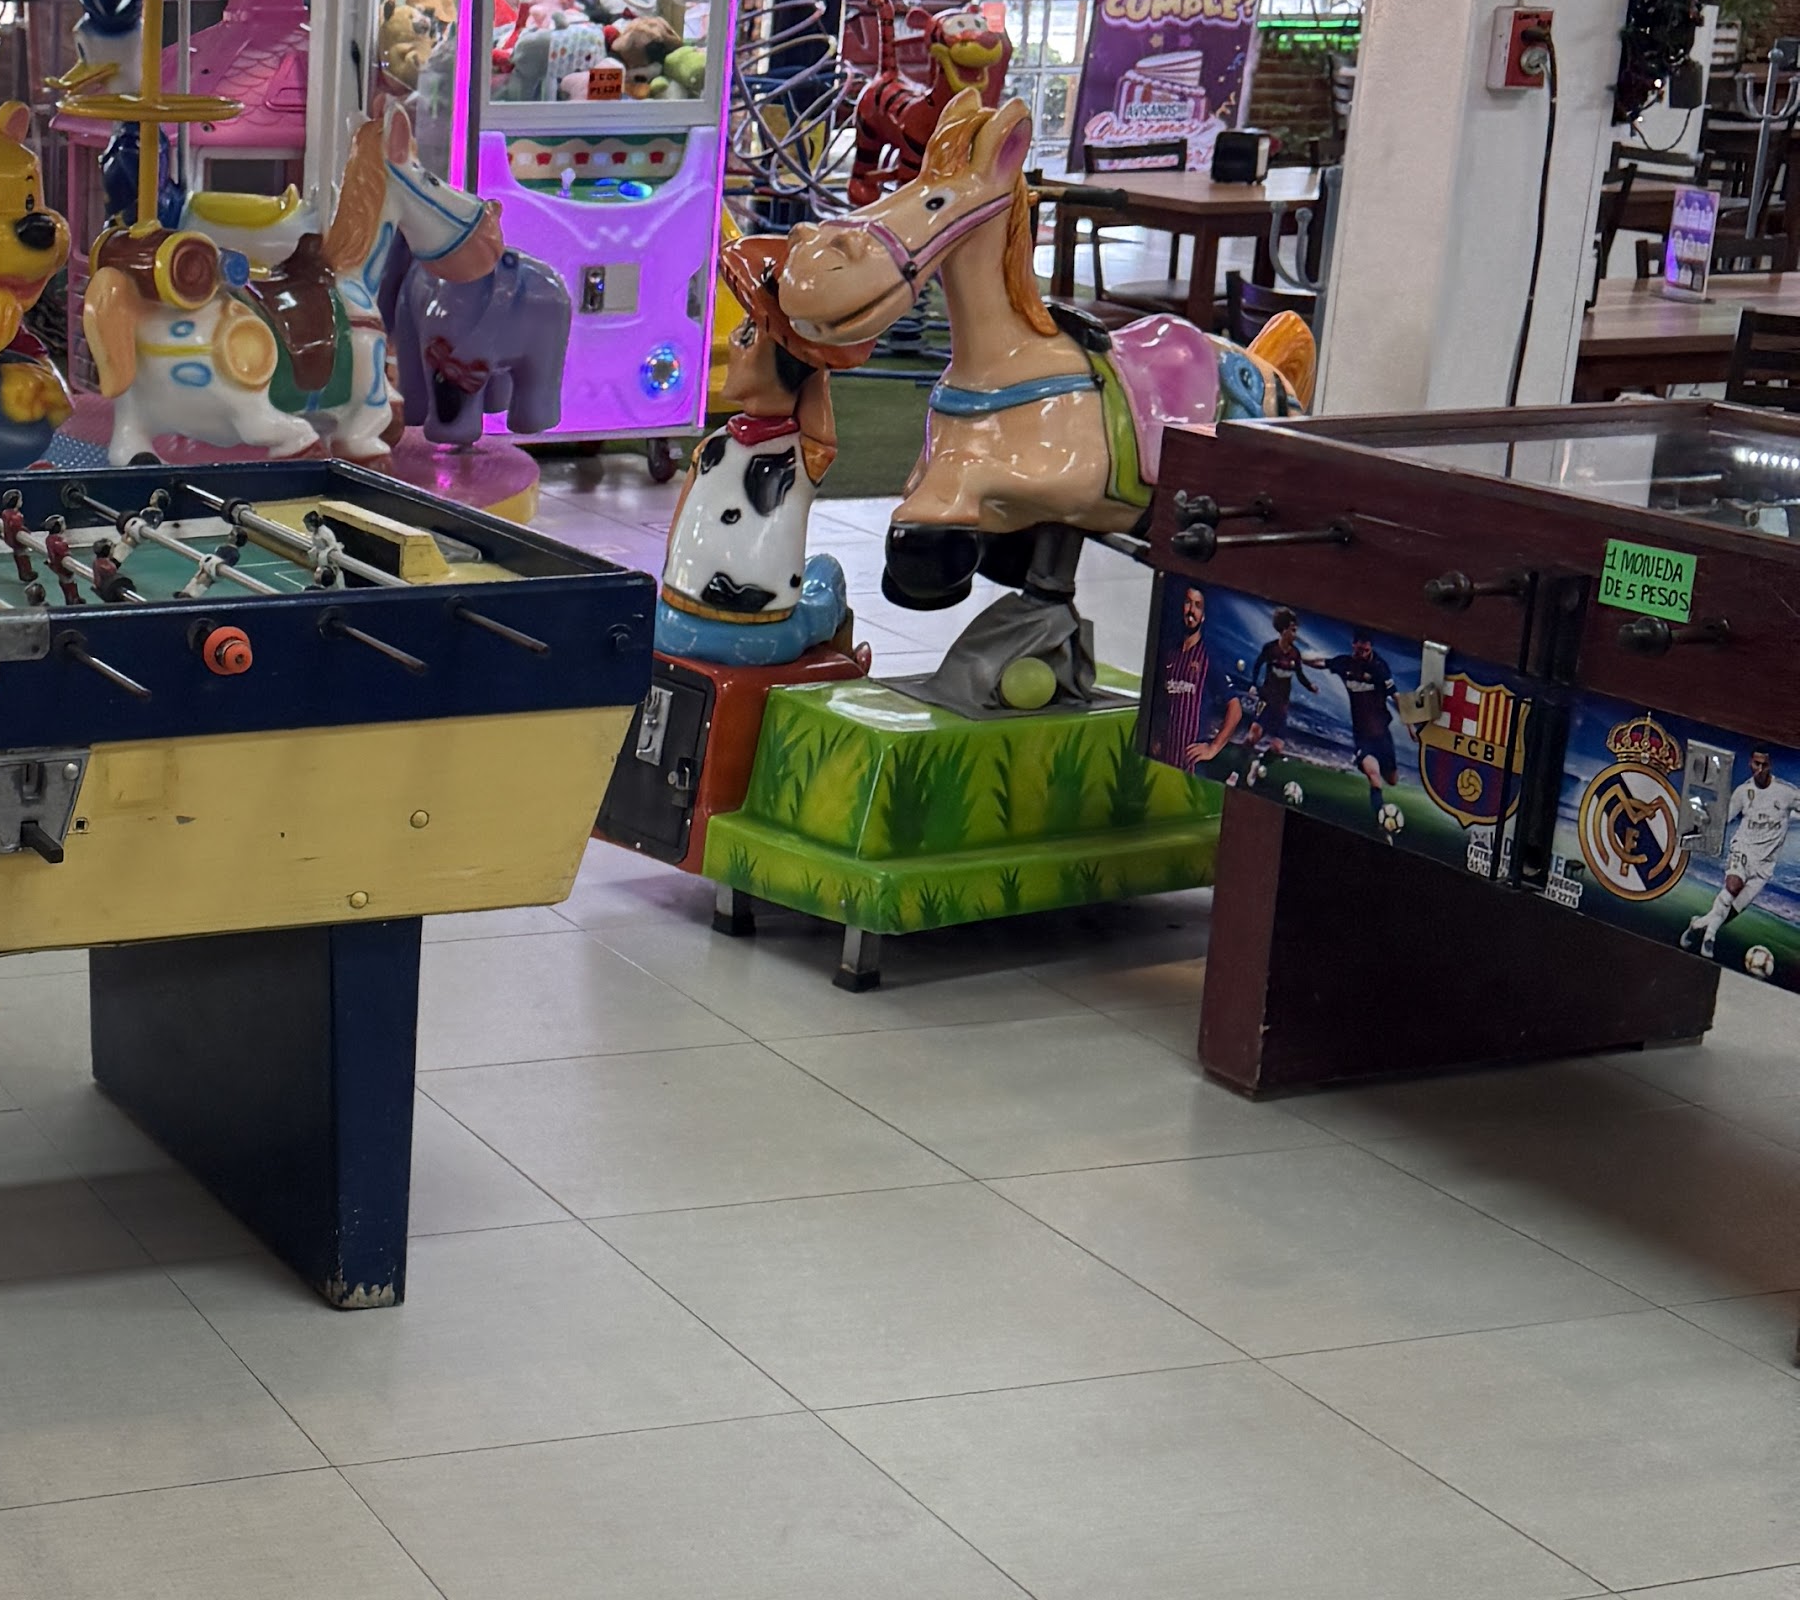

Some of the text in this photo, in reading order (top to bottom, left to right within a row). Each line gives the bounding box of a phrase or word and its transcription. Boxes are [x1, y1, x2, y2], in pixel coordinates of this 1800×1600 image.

[1605, 547, 1683, 583] 1 MONEDA
[1604, 576, 1689, 612] DE 5 PESOS
[1453, 735, 1495, 762] FCB
